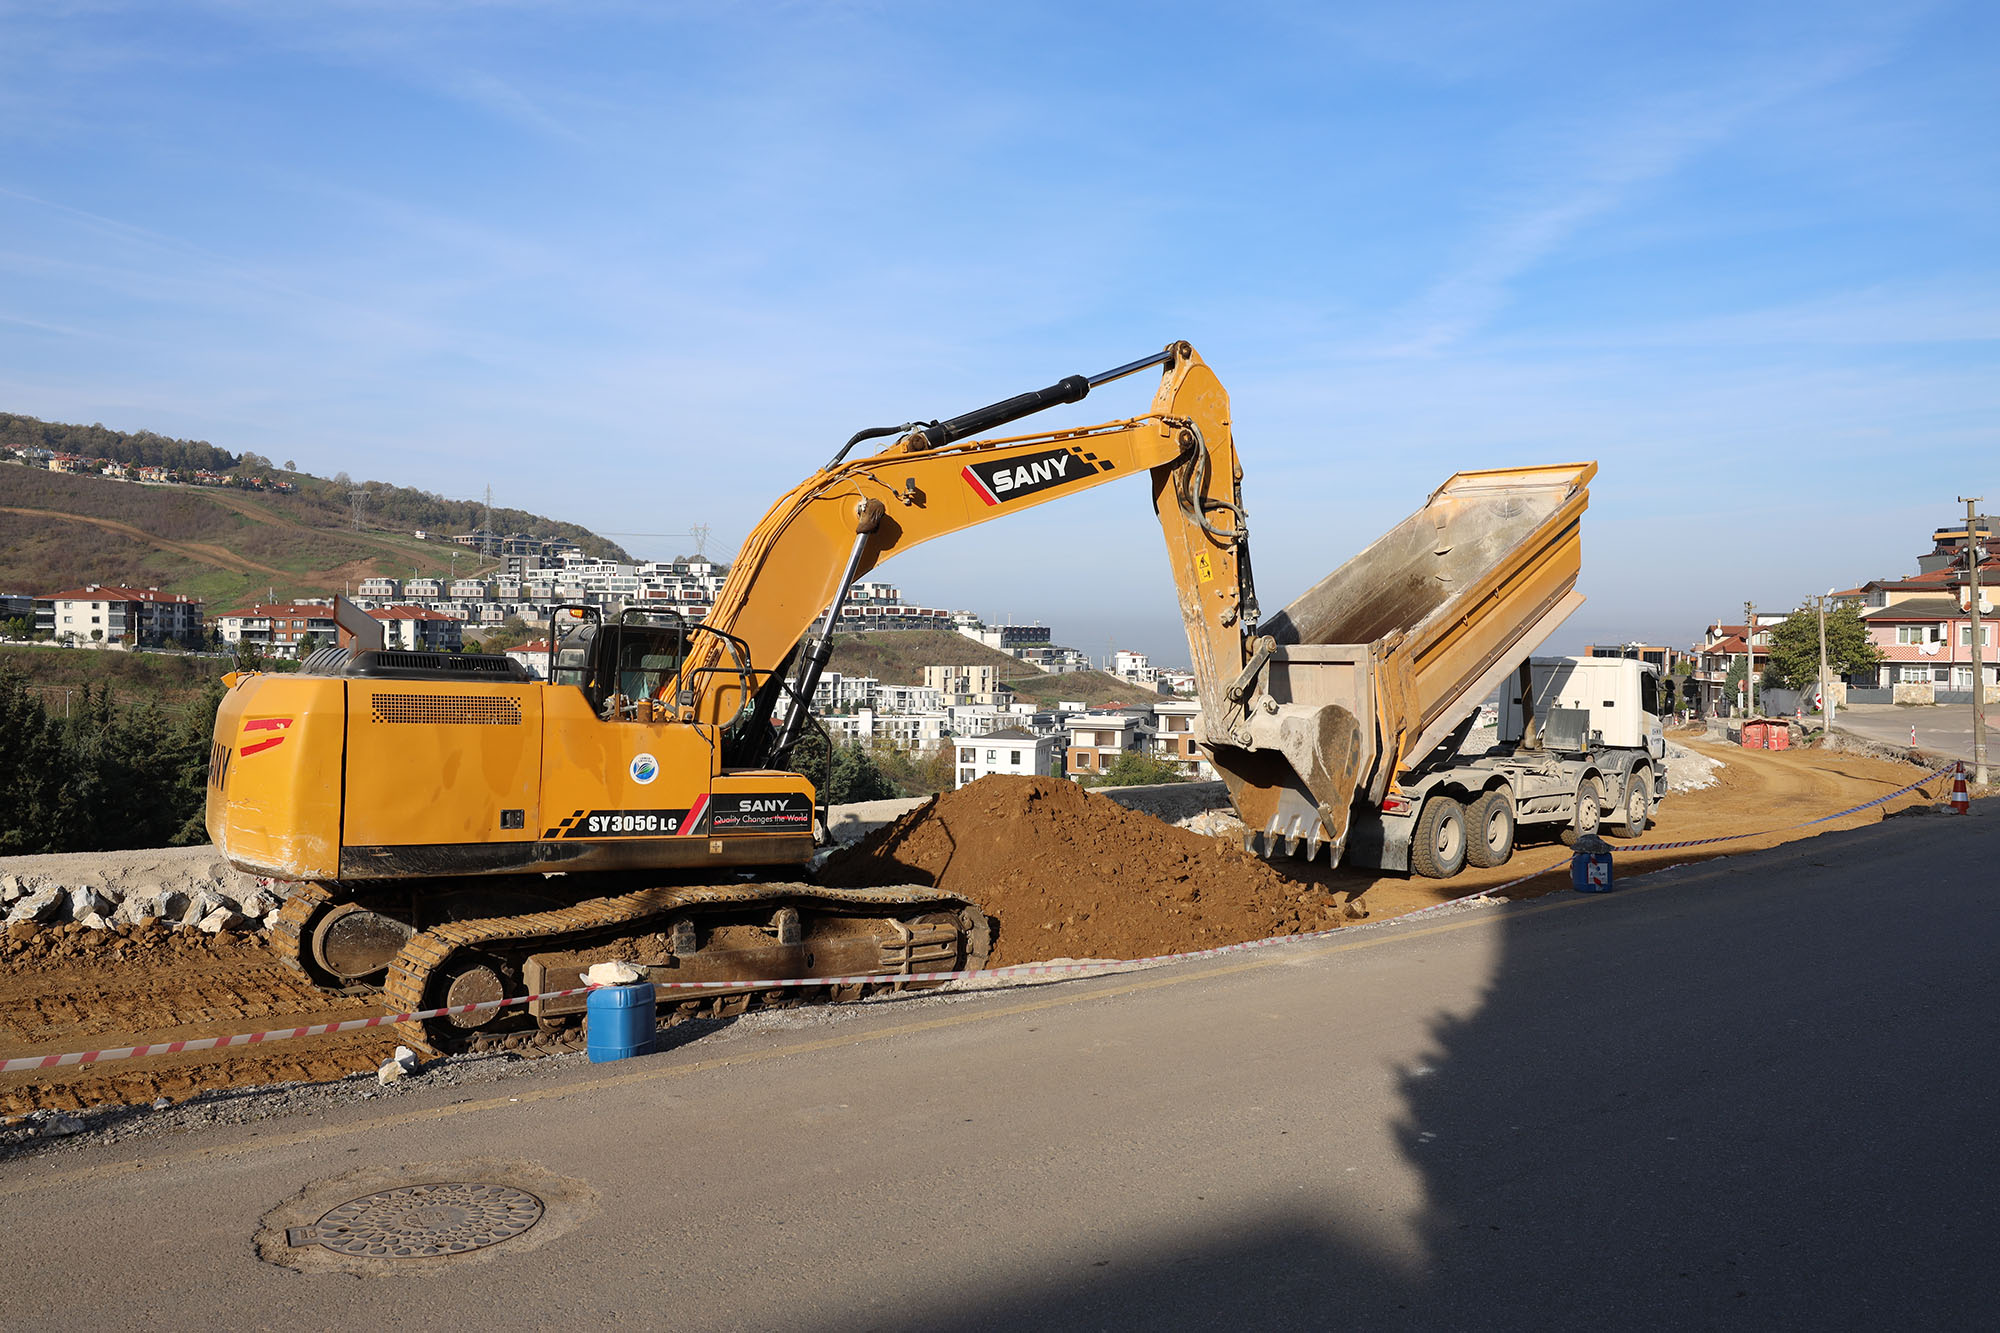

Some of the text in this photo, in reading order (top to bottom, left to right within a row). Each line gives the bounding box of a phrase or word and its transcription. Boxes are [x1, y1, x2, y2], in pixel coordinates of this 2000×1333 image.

[992, 454, 1069, 493] SANY
[739, 800, 789, 812] SANY
[588, 815, 677, 832] SY305C LC
[714, 813, 808, 825] Quality Changes the World
